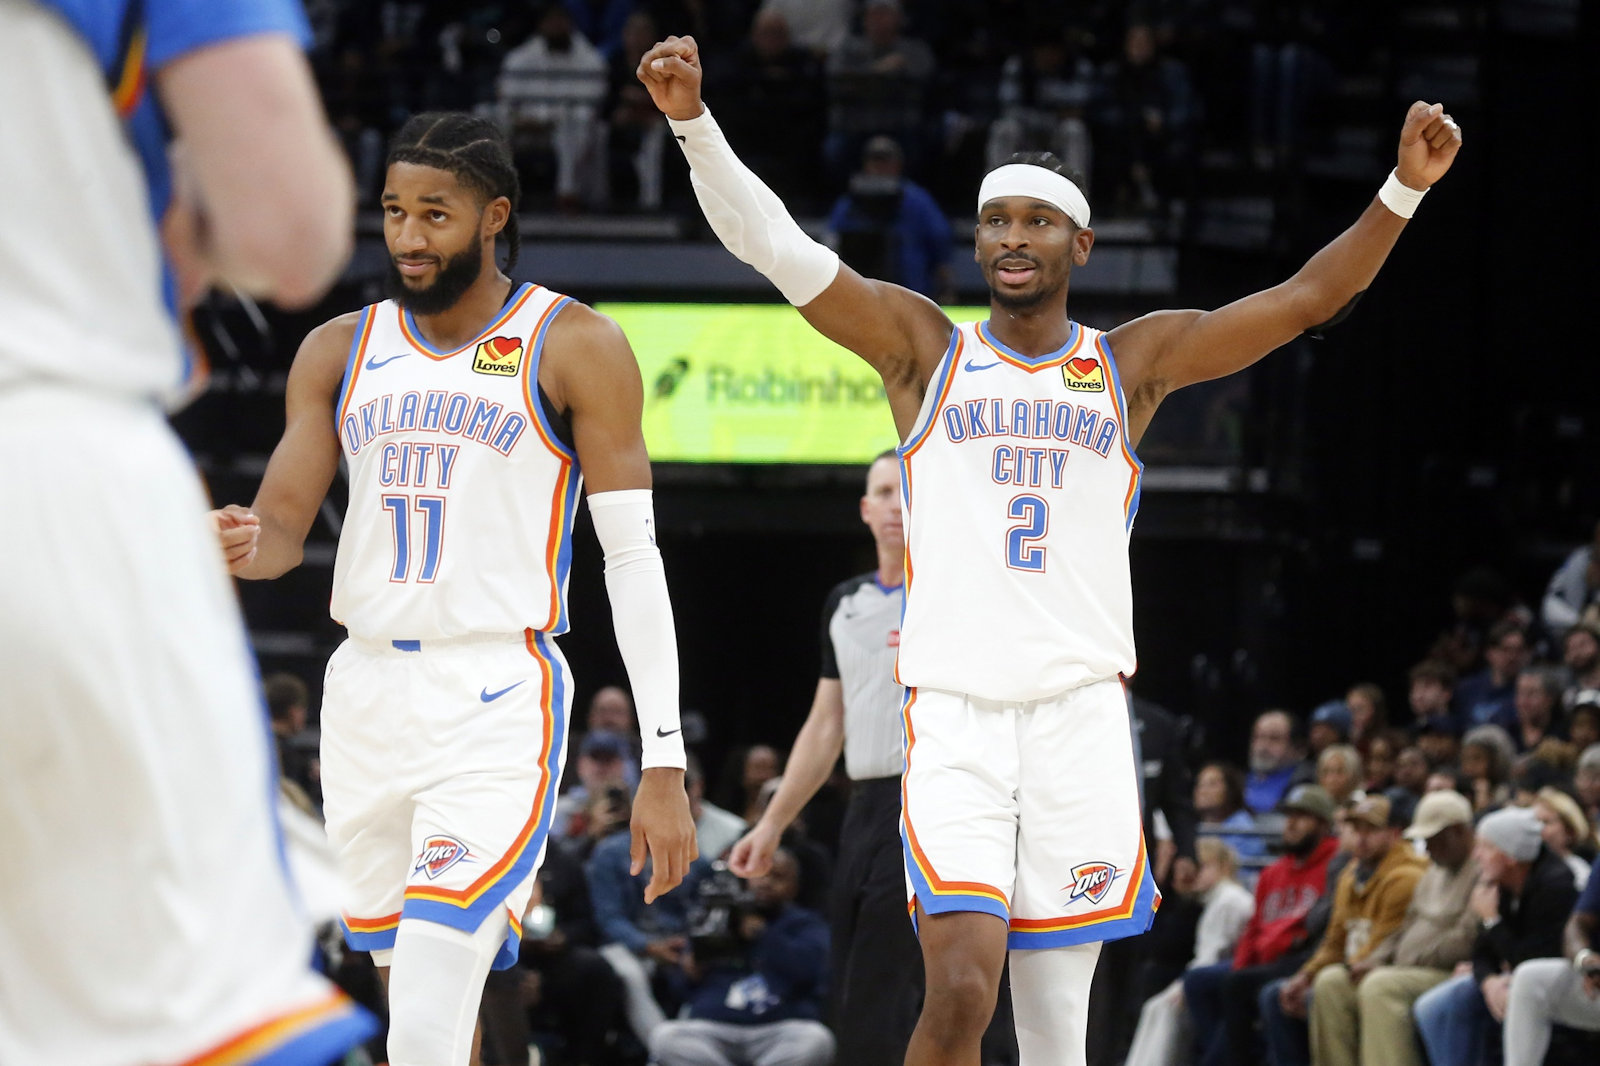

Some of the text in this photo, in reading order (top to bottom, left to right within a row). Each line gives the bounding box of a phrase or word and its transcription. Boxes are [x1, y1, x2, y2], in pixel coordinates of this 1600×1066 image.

[343, 389, 527, 457] OKLAHOMA
[943, 398, 1118, 459] OKLAHOMA
[379, 442, 460, 489] CITY
[991, 444, 1069, 489] CITY
[381, 494, 446, 584] 11
[1005, 492, 1050, 573] 2
[415, 845, 457, 870] OKC
[1070, 869, 1108, 898] OKC
